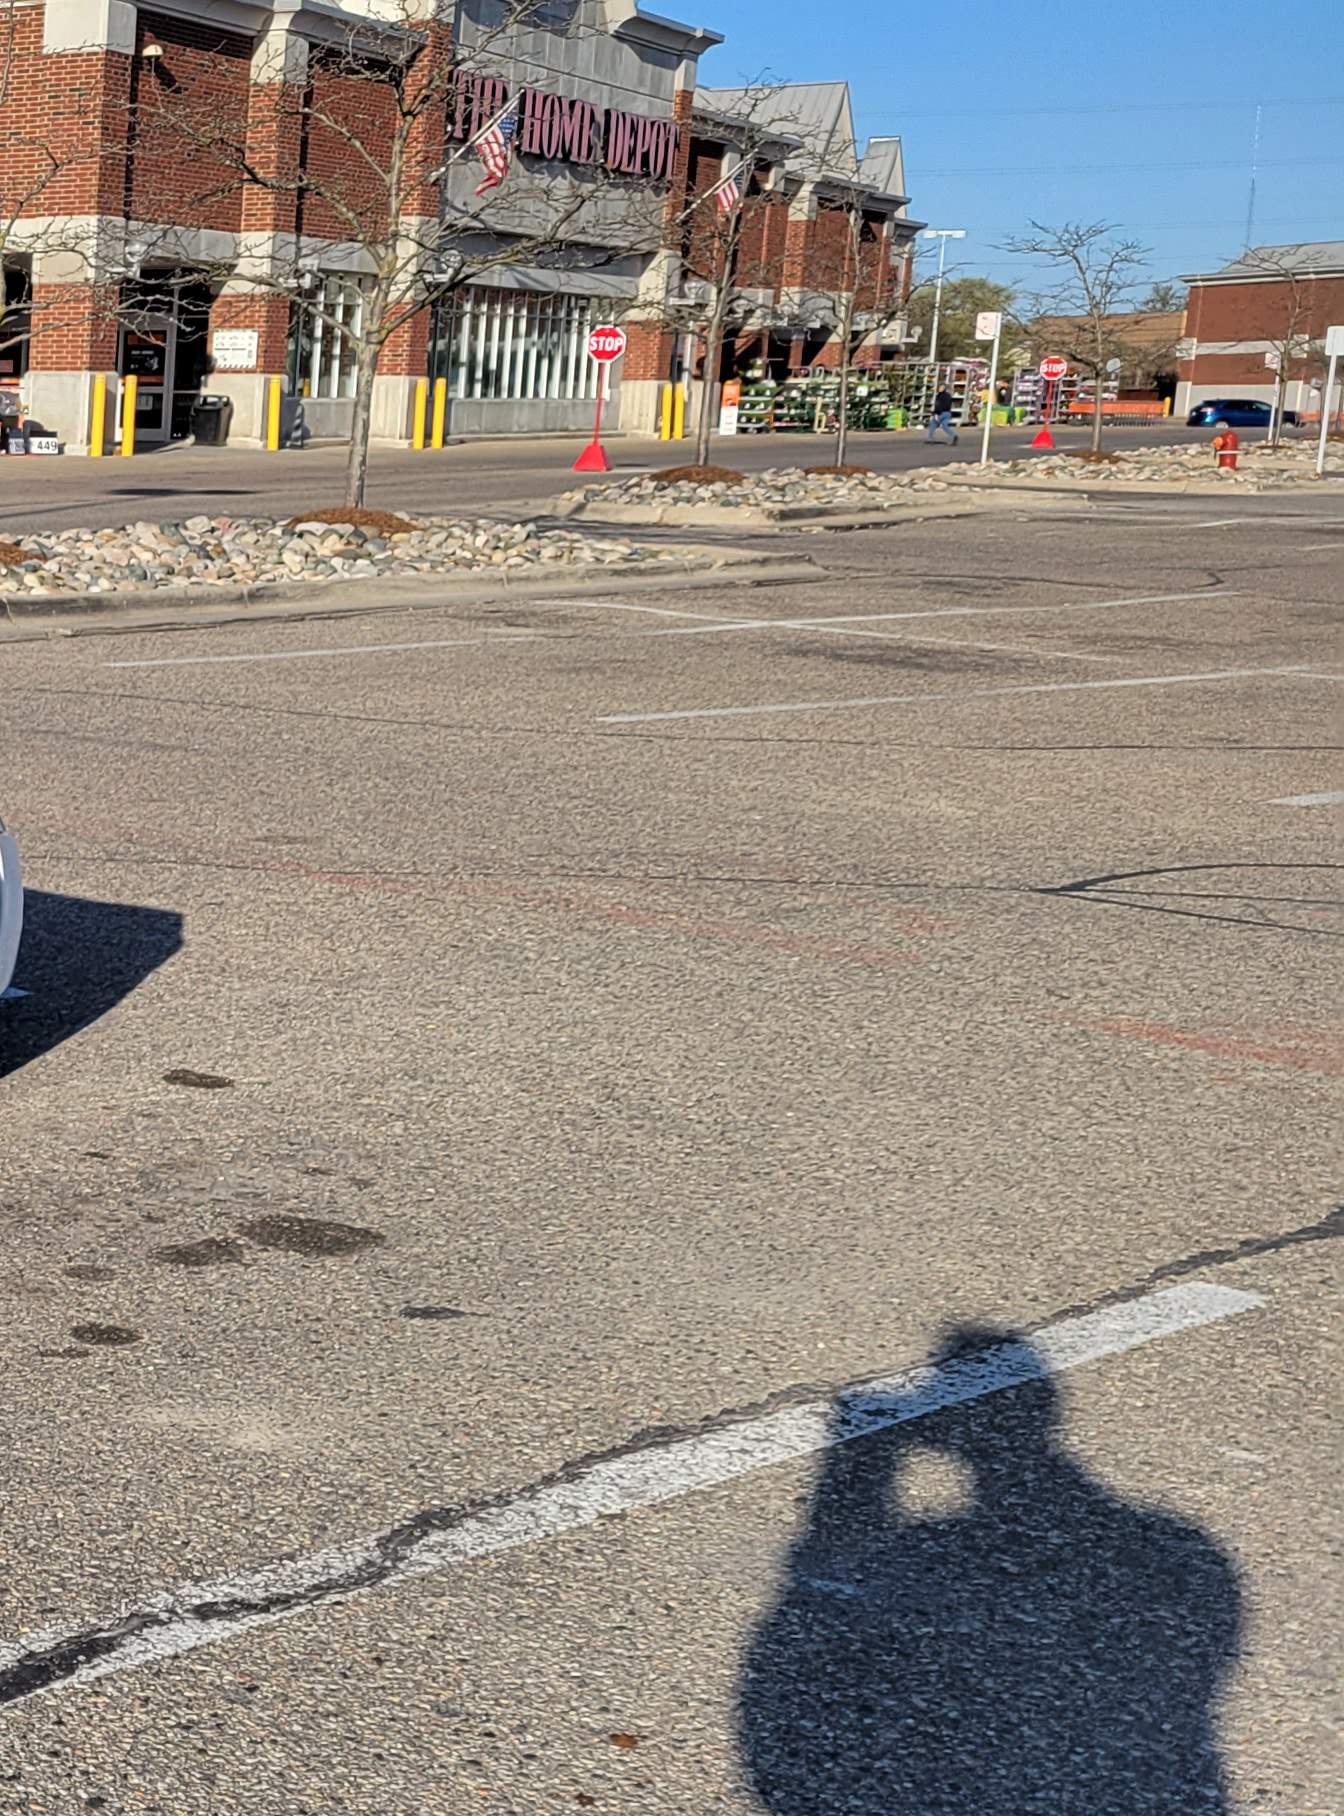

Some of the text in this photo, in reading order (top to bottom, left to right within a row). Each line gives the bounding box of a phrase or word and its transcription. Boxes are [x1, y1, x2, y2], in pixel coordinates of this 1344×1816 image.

[523, 88, 599, 164] HOME
[606, 108, 680, 180] DEPOT
[590, 336, 624, 351] STOP
[1040, 363, 1065, 373] STOP
